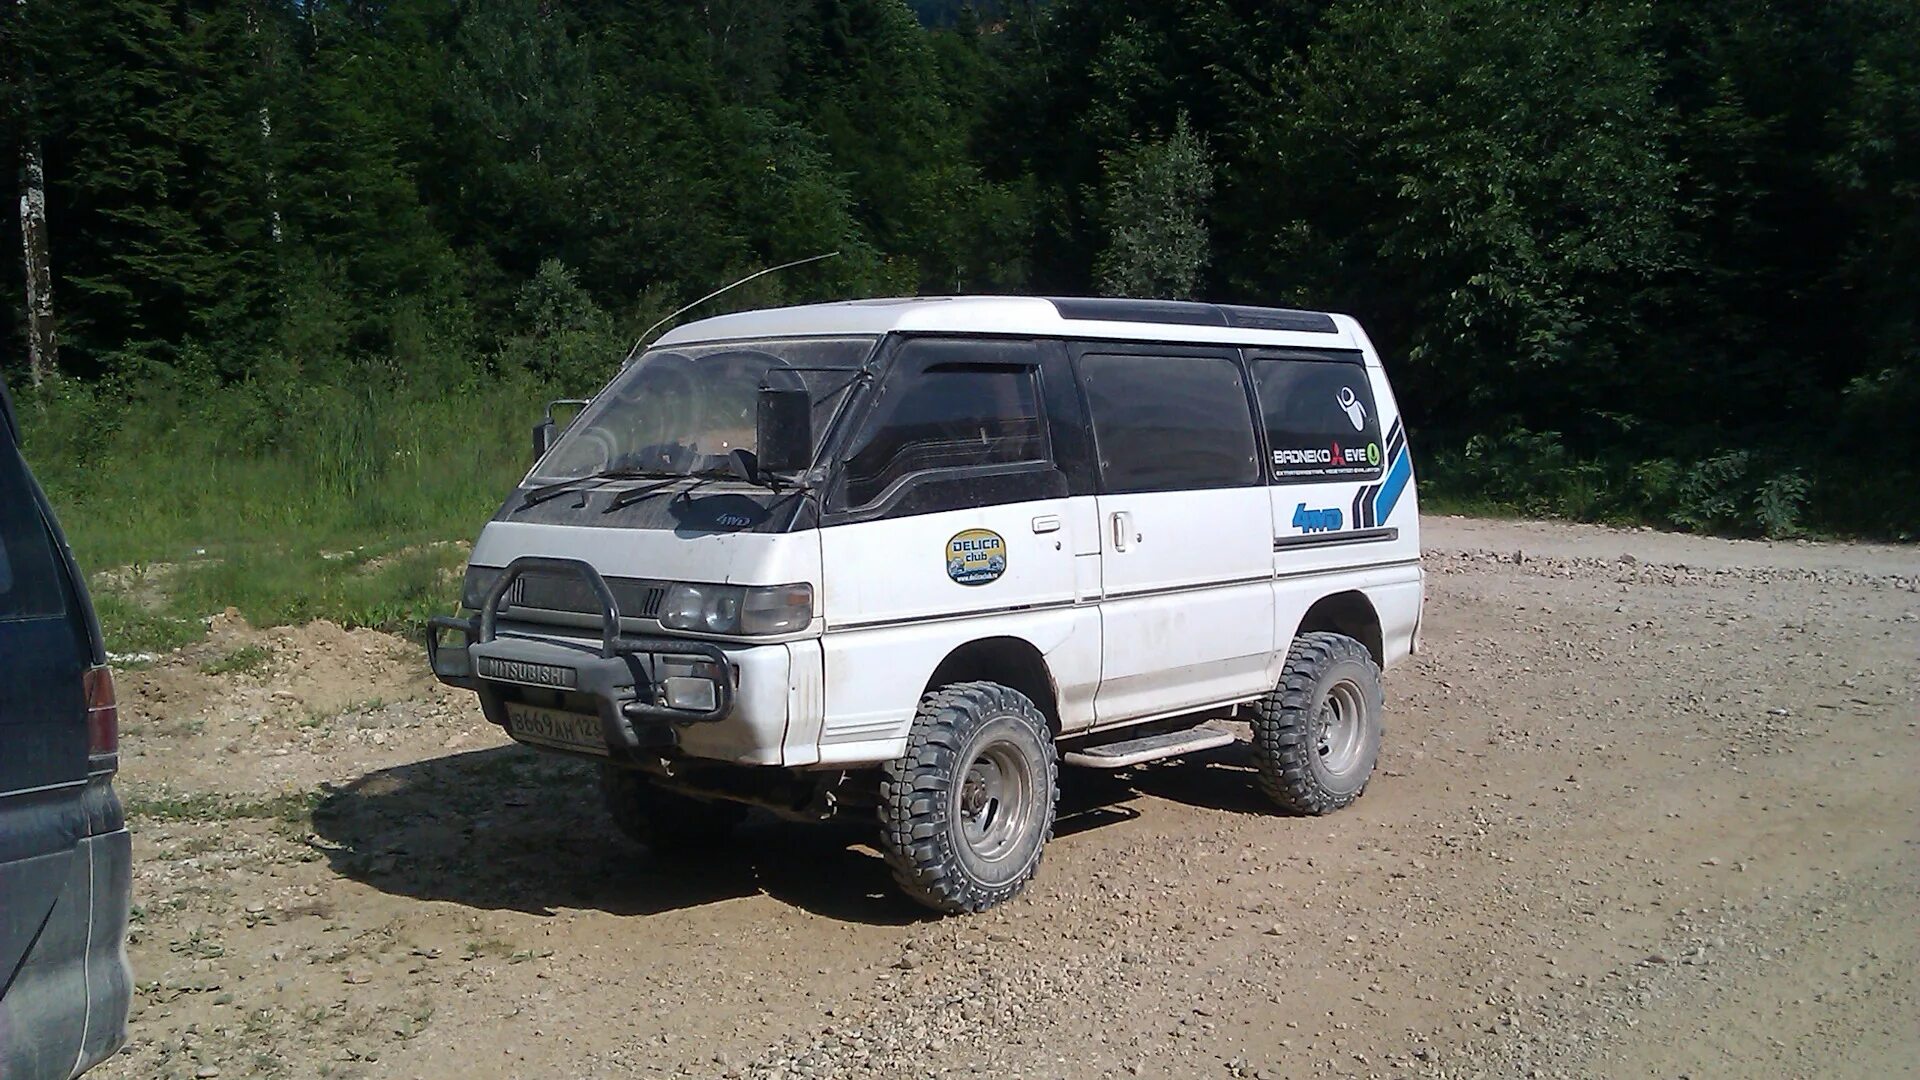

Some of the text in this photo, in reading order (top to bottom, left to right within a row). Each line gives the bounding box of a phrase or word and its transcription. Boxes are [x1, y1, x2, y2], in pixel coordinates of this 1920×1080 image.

[1344, 448, 1367, 462] EVE
[716, 513, 751, 526] 4WD
[1292, 502, 1343, 533] 4WD
[953, 539, 999, 552] DELICA
[965, 552, 988, 562] club
[488, 659, 566, 685] MITSUBISHI
